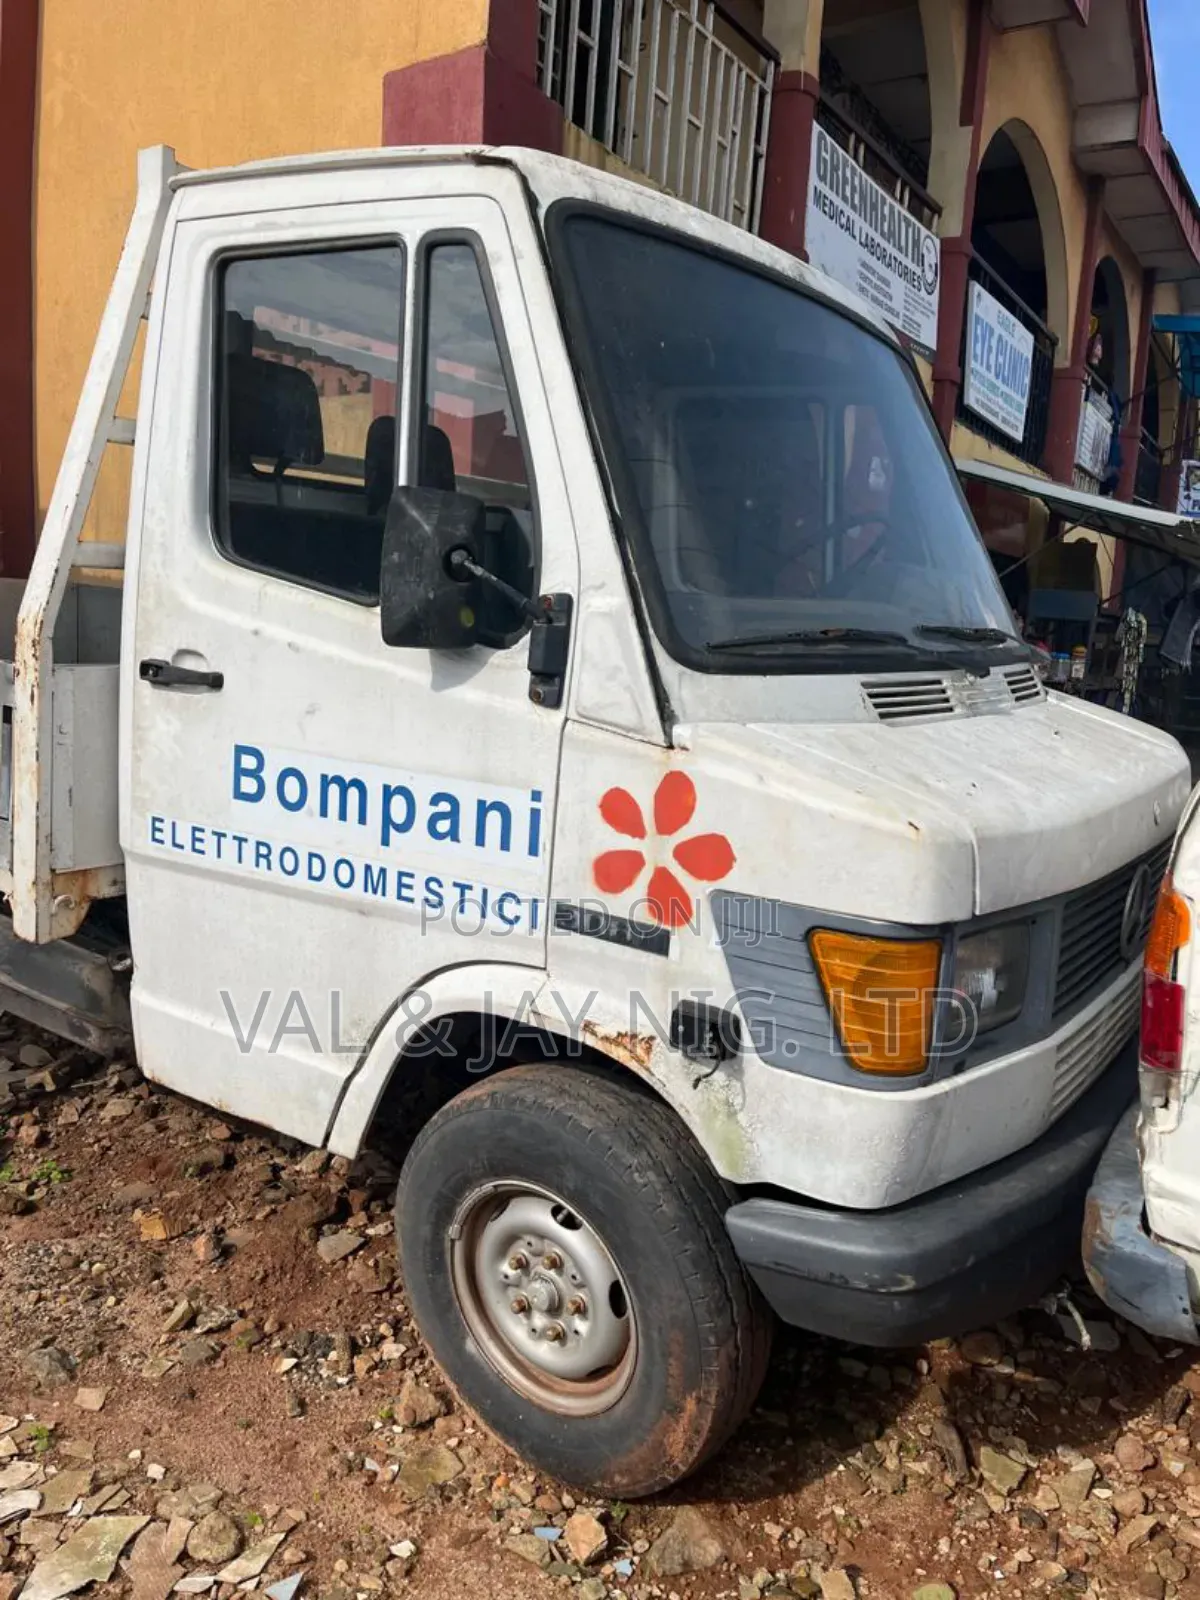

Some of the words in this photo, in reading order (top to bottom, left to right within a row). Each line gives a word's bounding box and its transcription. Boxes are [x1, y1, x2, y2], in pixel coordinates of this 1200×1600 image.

[813, 185, 857, 241] MEDICAL
[858, 231, 923, 292] LABORATORIES
[816, 130, 922, 267] GREENHEALTH
[973, 314, 994, 374] EYE
[995, 333, 1030, 399] CLINIC
[232, 744, 543, 858] Bompani
[150, 815, 539, 930] ELETTRODOMESTICI
